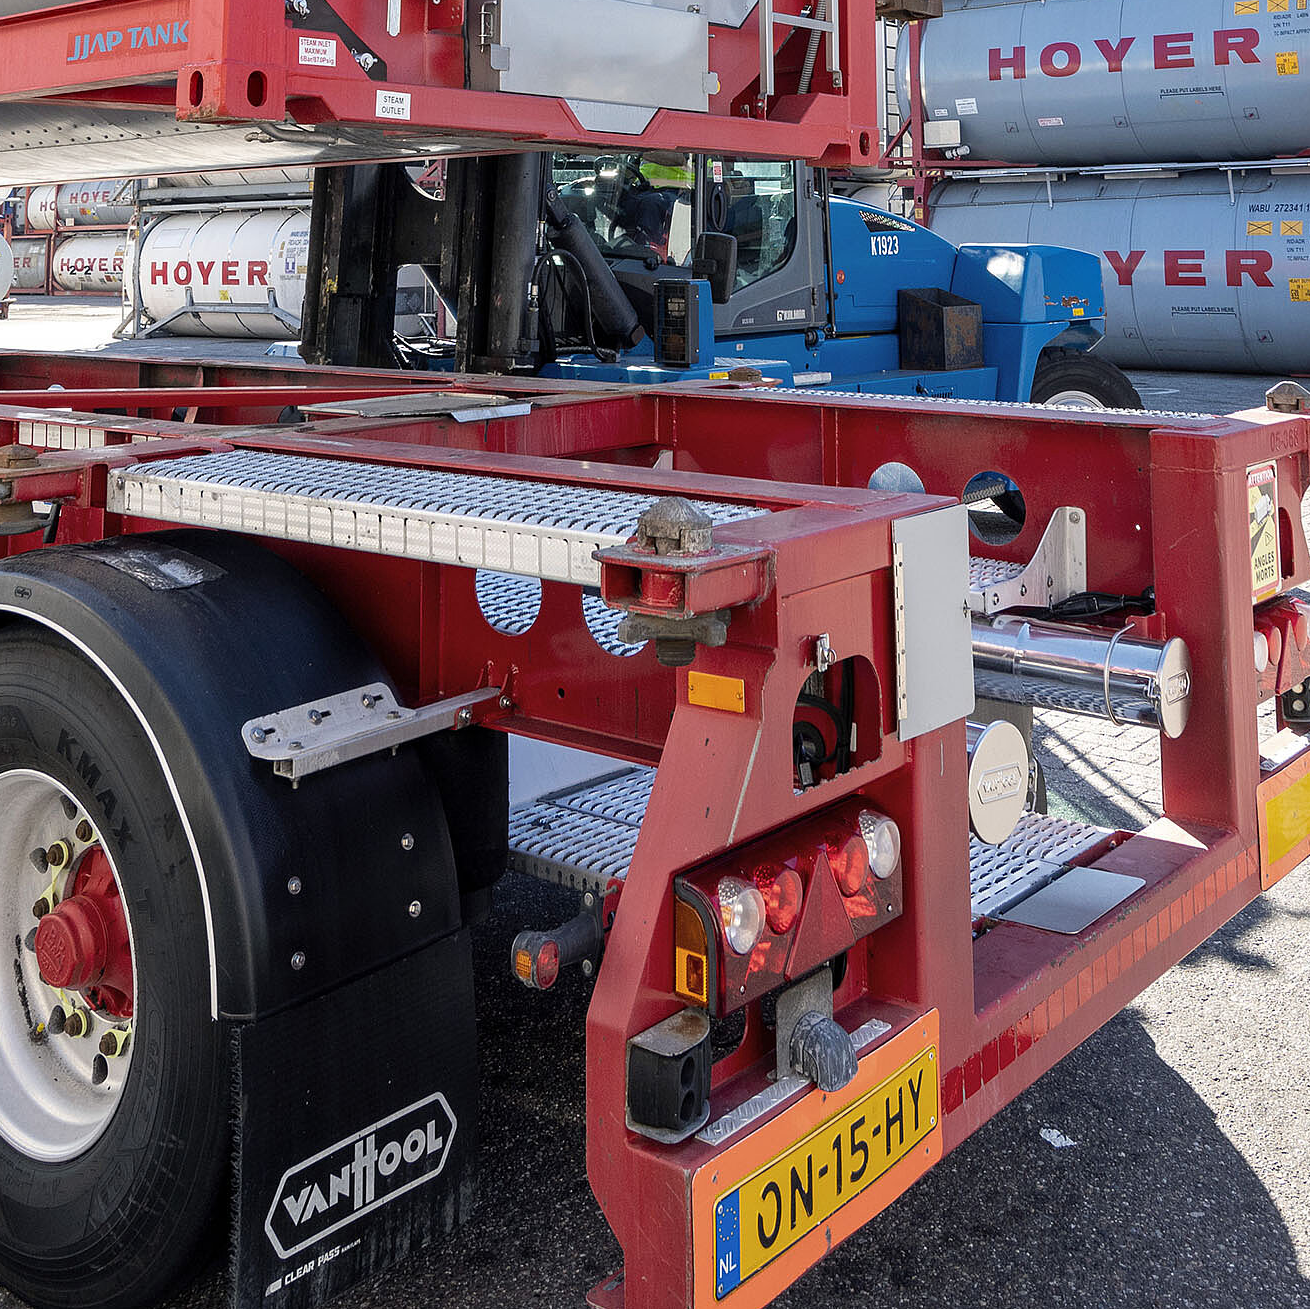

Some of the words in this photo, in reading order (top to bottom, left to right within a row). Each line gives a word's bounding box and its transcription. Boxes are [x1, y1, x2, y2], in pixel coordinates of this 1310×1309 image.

[127, 20, 189, 49] TANK
[300, 39, 317, 47] STEAM
[304, 47, 327, 55] MAXIMUM
[988, 27, 1261, 82] HOYER
[381, 106, 405, 115] OUTLET
[383, 95, 404, 104] STEAM
[1248, 204, 1270, 212] WABU
[1274, 203, 1303, 212] 272341
[870, 235, 899, 256] K1923
[60, 257, 124, 272] HOYER
[150, 261, 268, 286] HOYER
[1102, 249, 1275, 288] YER
[1254, 551, 1275, 570] ANGLES
[1255, 564, 1275, 583] MORTS
[56, 729, 132, 854] KMAX
[756, 1067, 926, 1250] ON-15-HY
[282, 1120, 443, 1226] VANHOOL
[284, 1261, 315, 1286] CLEAR
[317, 1245, 341, 1267] PASS
[719, 1252, 737, 1277] NL
